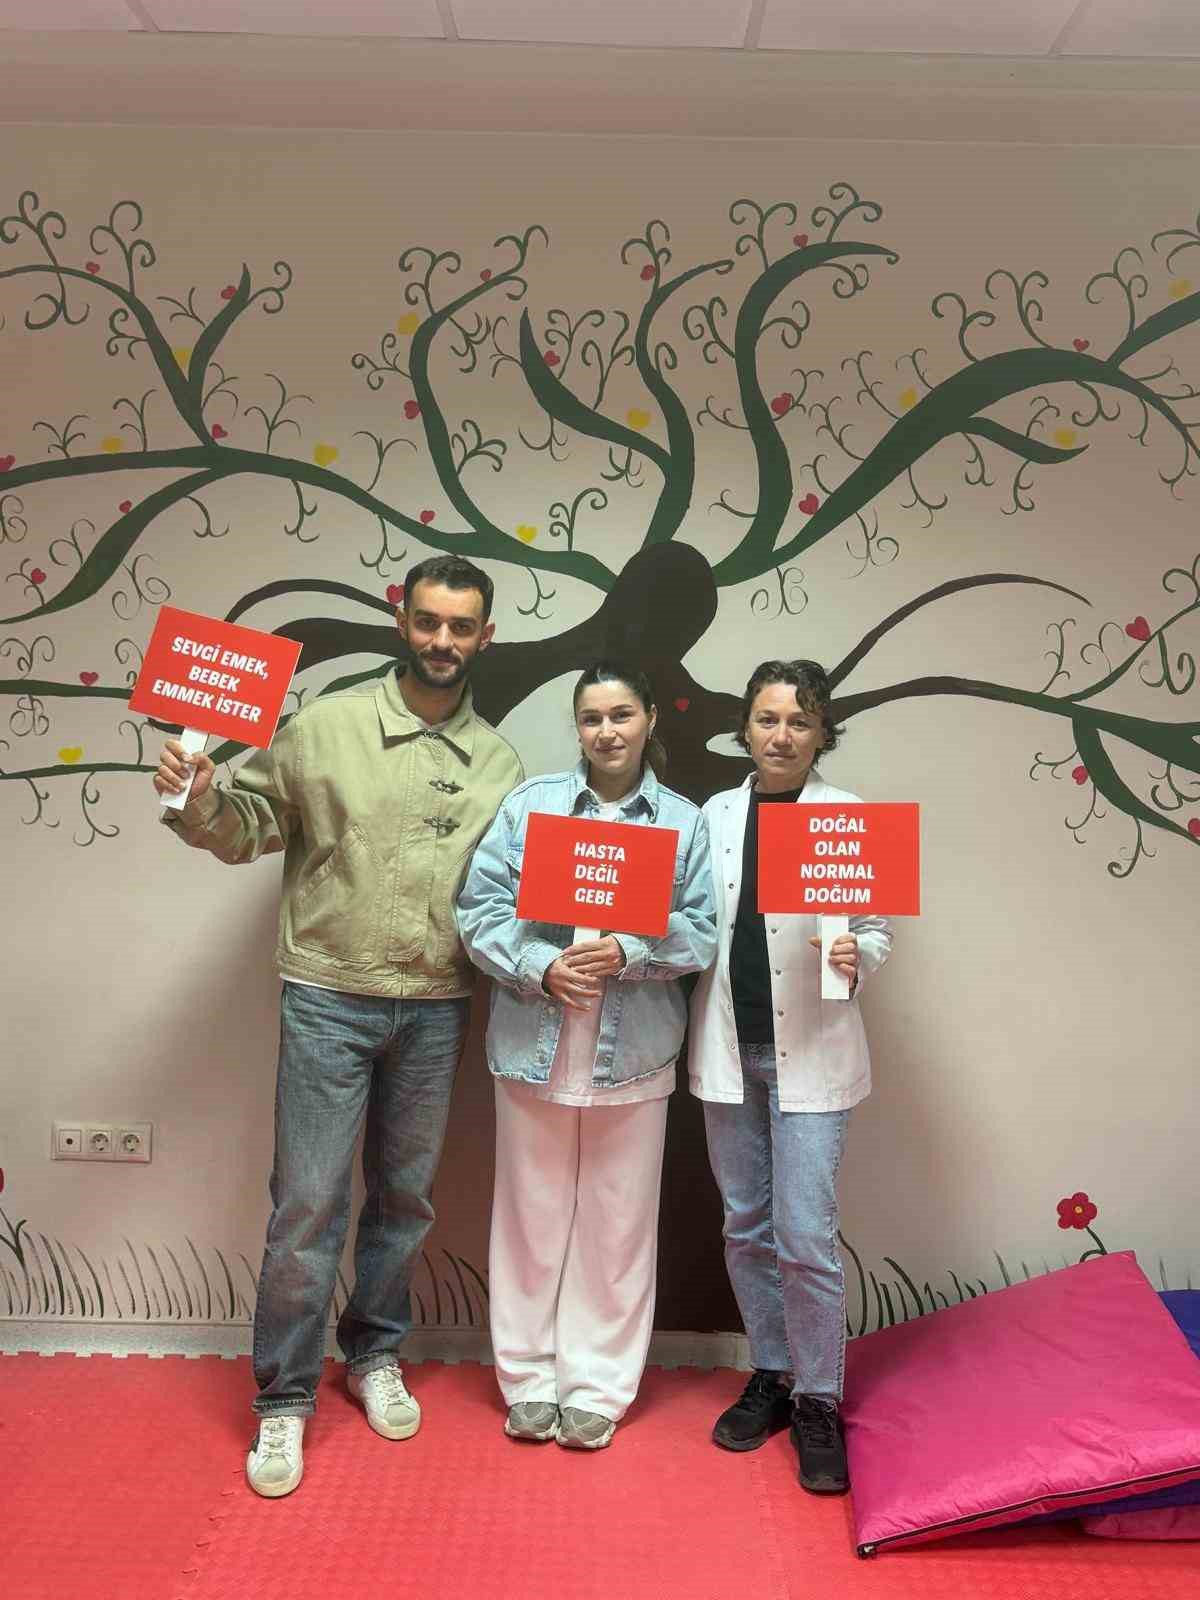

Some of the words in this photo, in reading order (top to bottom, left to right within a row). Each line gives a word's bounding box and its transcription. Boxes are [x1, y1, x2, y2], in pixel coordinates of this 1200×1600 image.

[171, 636, 221, 662] SEVGİ
[220, 650, 269, 680] EMEK,
[188, 665, 241, 692] BEBEK
[152, 679, 215, 709] EMMEK
[215, 694, 262, 723] İSTER
[809, 813, 867, 833] DOĞAL
[574, 841, 625, 862] HASTA
[814, 840, 861, 856] OLAN
[574, 863, 619, 884] DEĞİL
[800, 863, 875, 880] NORMAL
[575, 887, 615, 906] GEBE
[804, 883, 871, 904] DOĞUM
